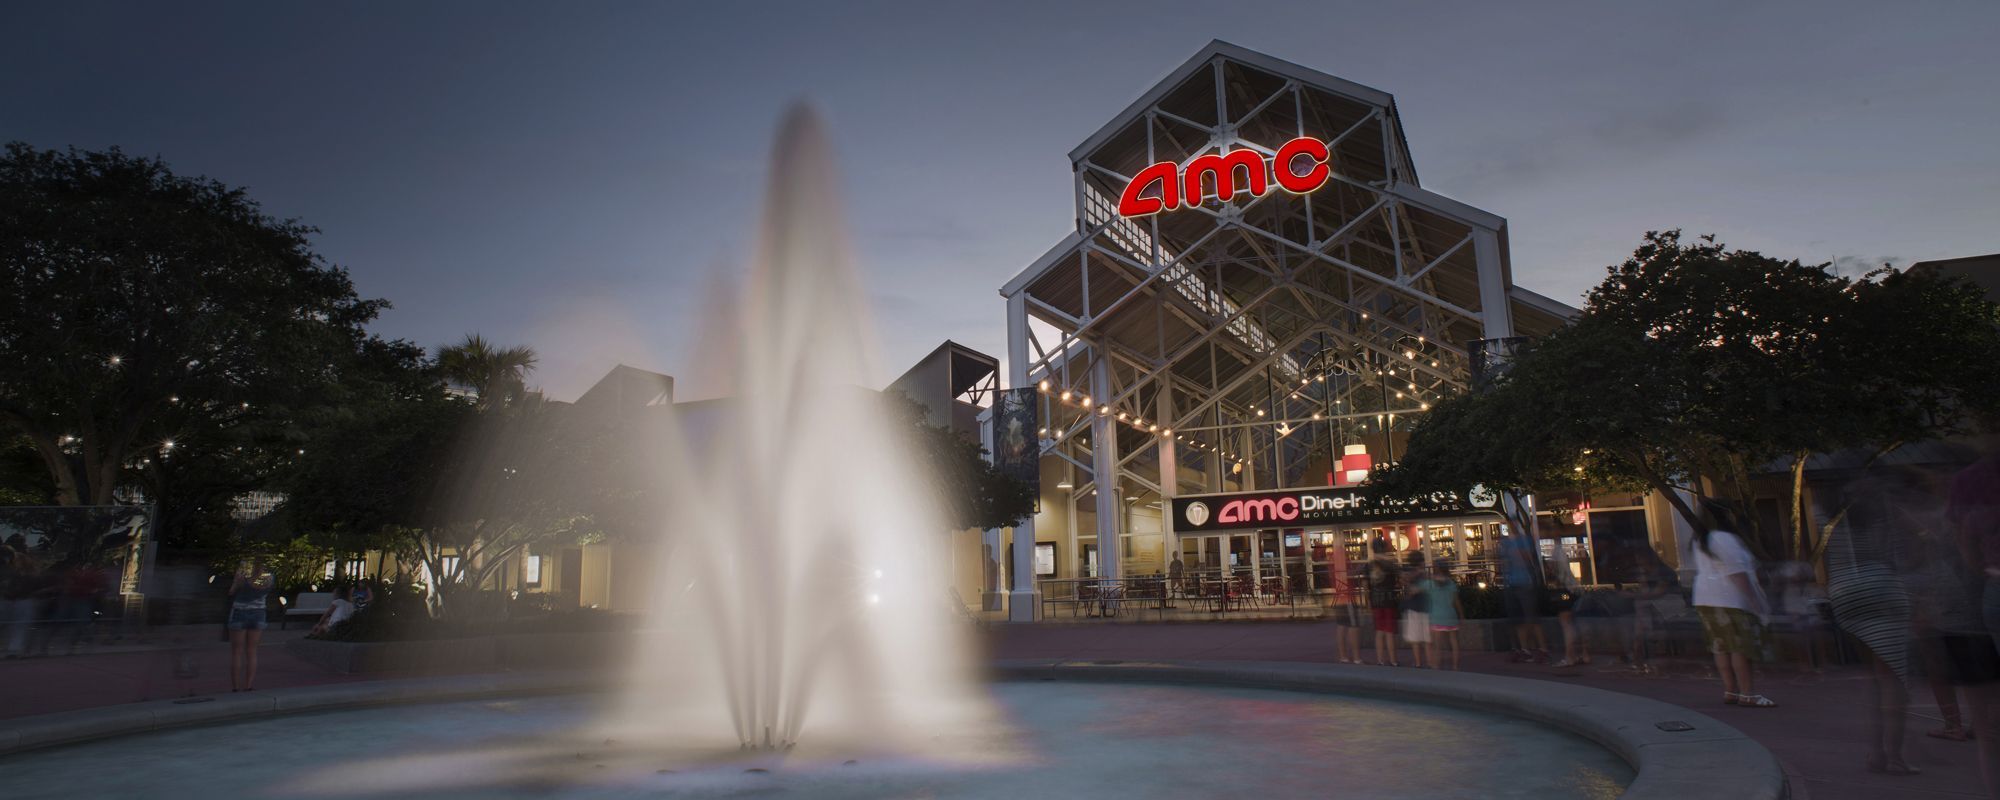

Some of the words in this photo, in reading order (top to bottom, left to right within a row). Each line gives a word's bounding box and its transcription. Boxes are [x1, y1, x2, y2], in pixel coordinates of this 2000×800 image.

[1118, 136, 1331, 218] amc
[1218, 497, 1299, 523] amc
[1303, 510, 1353, 519] MOVIES
